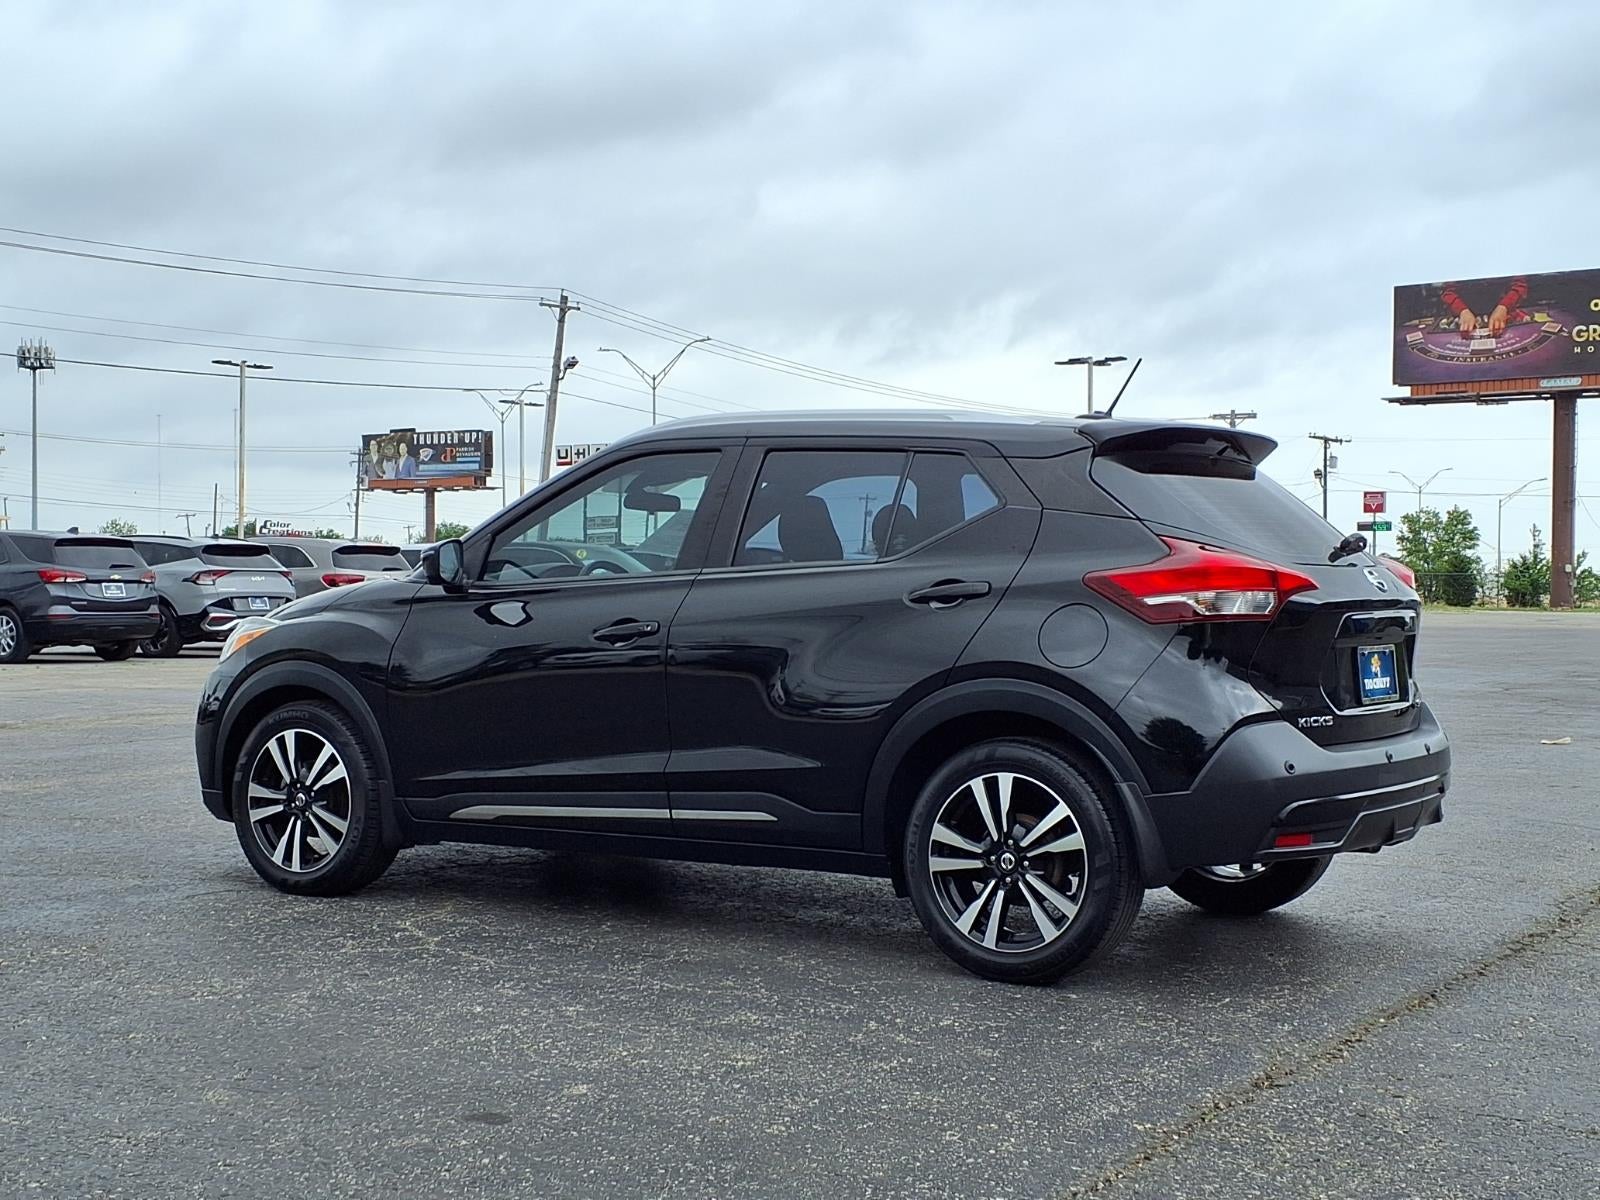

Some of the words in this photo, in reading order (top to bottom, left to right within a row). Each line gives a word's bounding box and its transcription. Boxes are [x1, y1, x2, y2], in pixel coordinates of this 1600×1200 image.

[1572, 325, 1600, 342] GR
[413, 432, 458, 445] THUNDER
[464, 431, 482, 443] UP!
[263, 519, 291, 528] Color
[259, 527, 313, 536] Creations
[1297, 715, 1333, 728] KICKS
